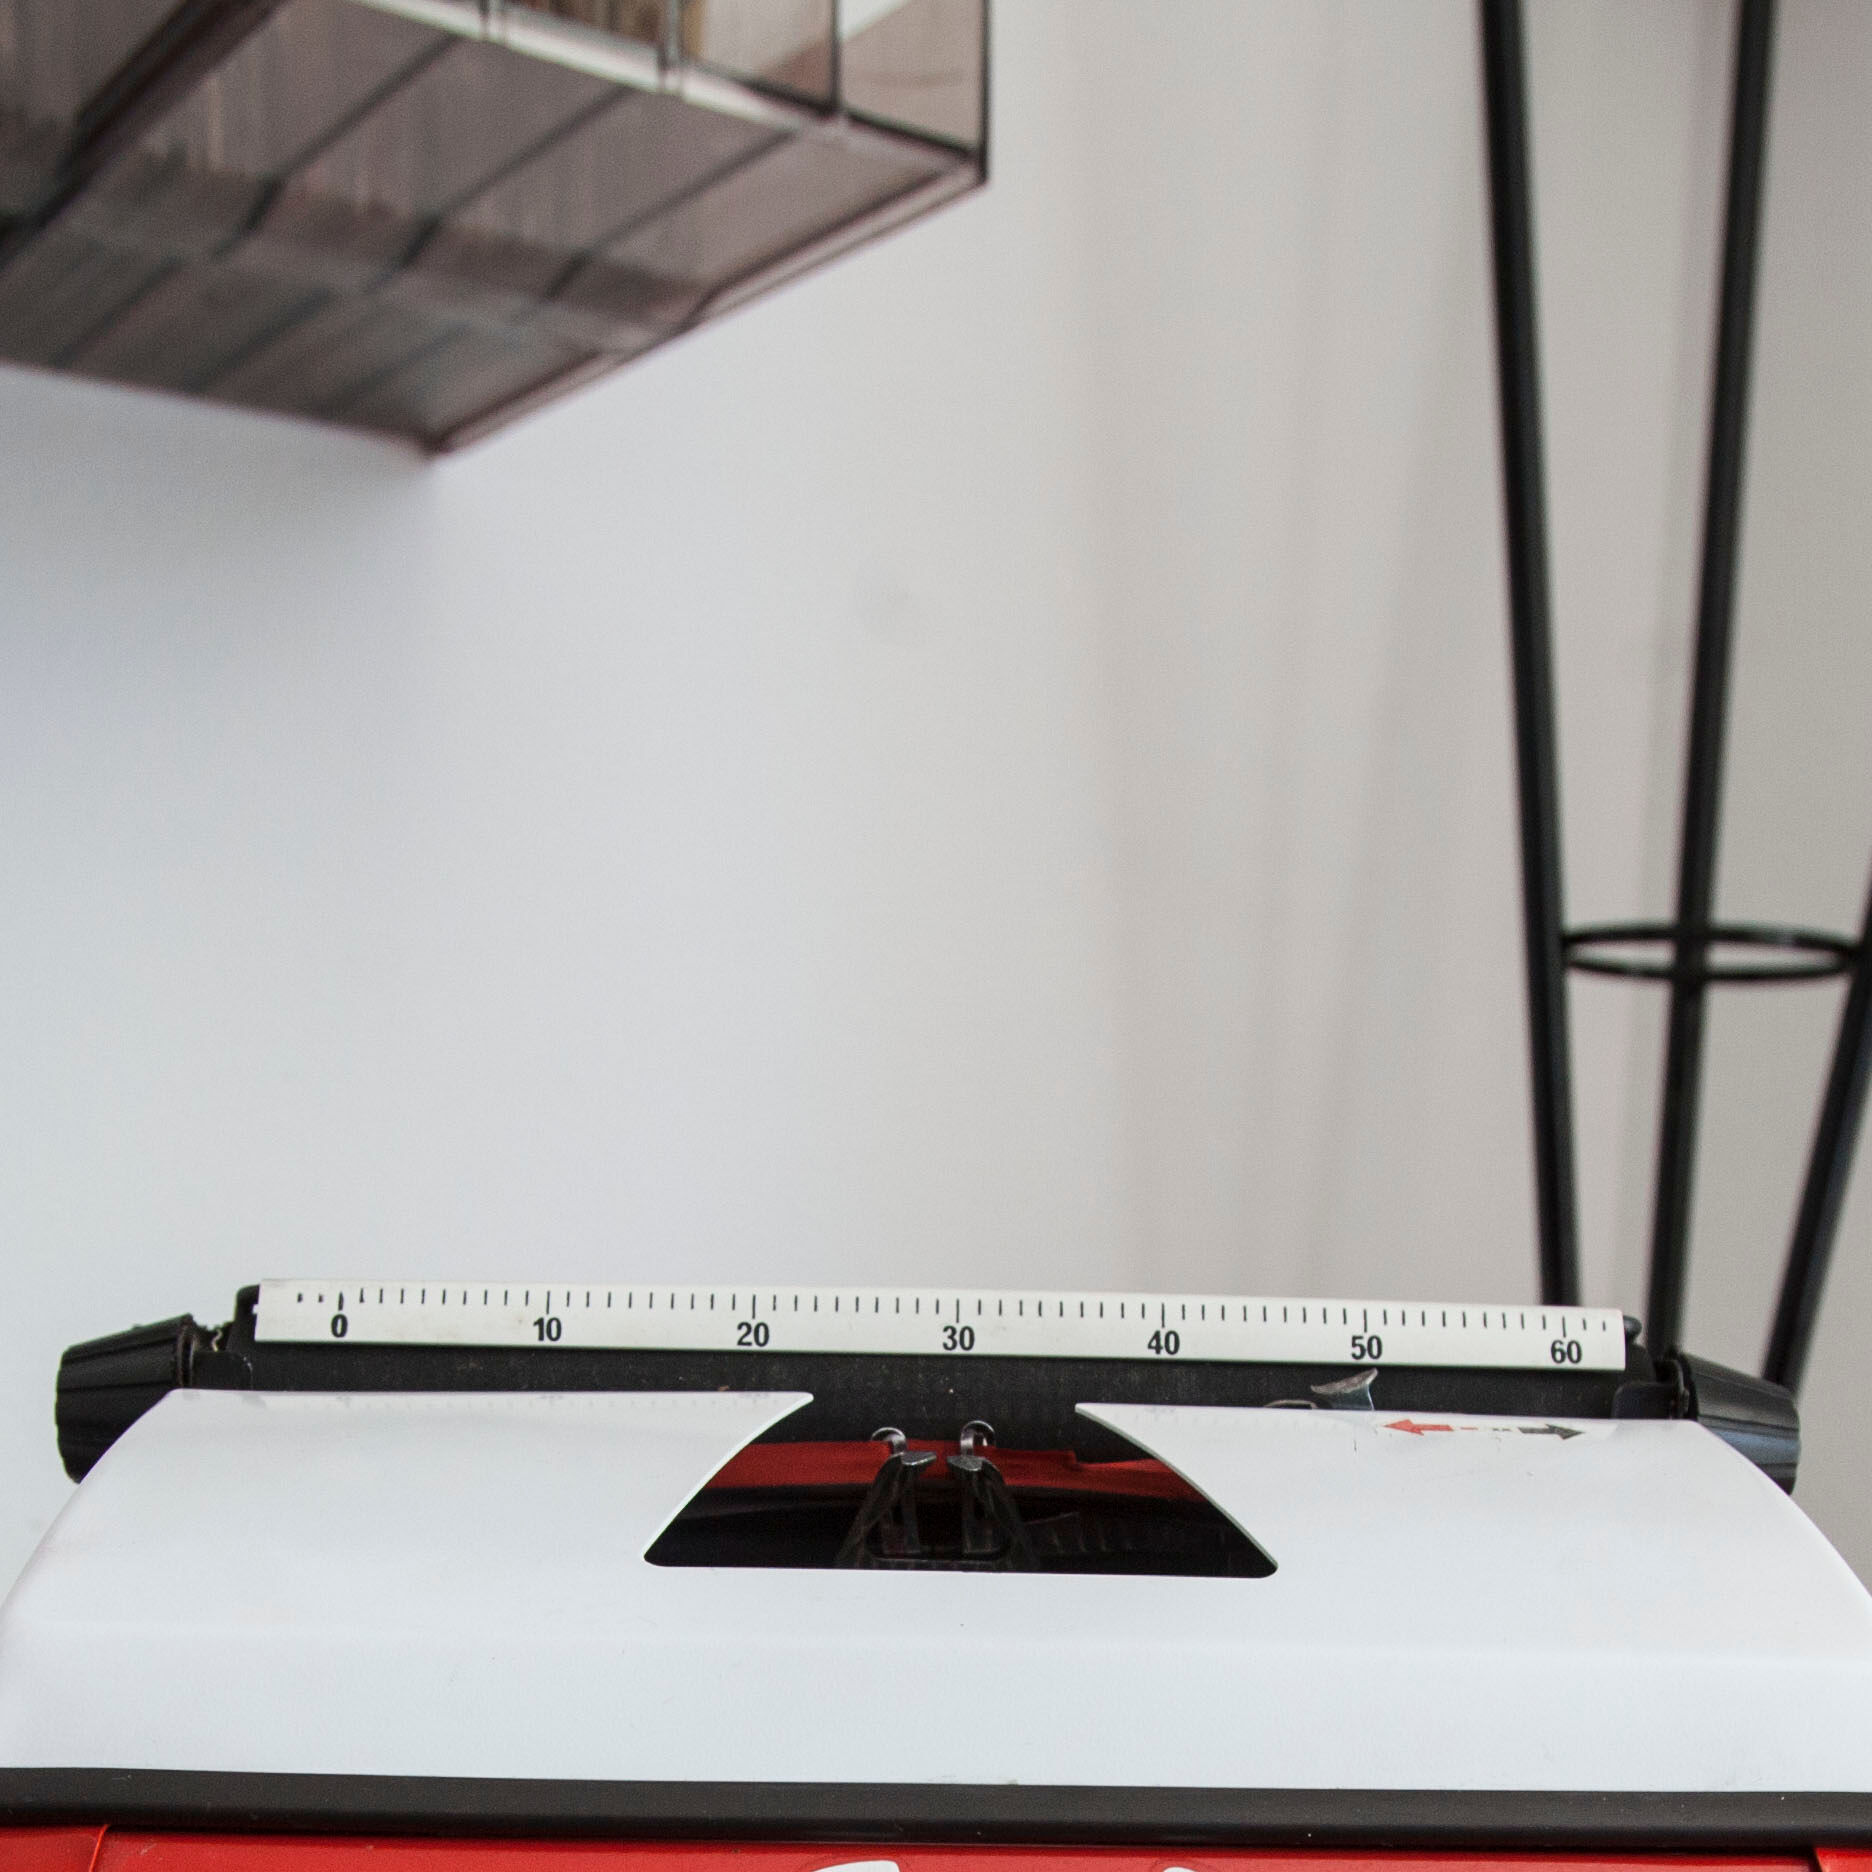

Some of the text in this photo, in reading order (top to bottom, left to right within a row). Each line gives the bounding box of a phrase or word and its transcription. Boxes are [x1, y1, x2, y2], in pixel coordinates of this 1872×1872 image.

[329, 1313, 1583, 1365] 0 10 20 30 40 50 60
